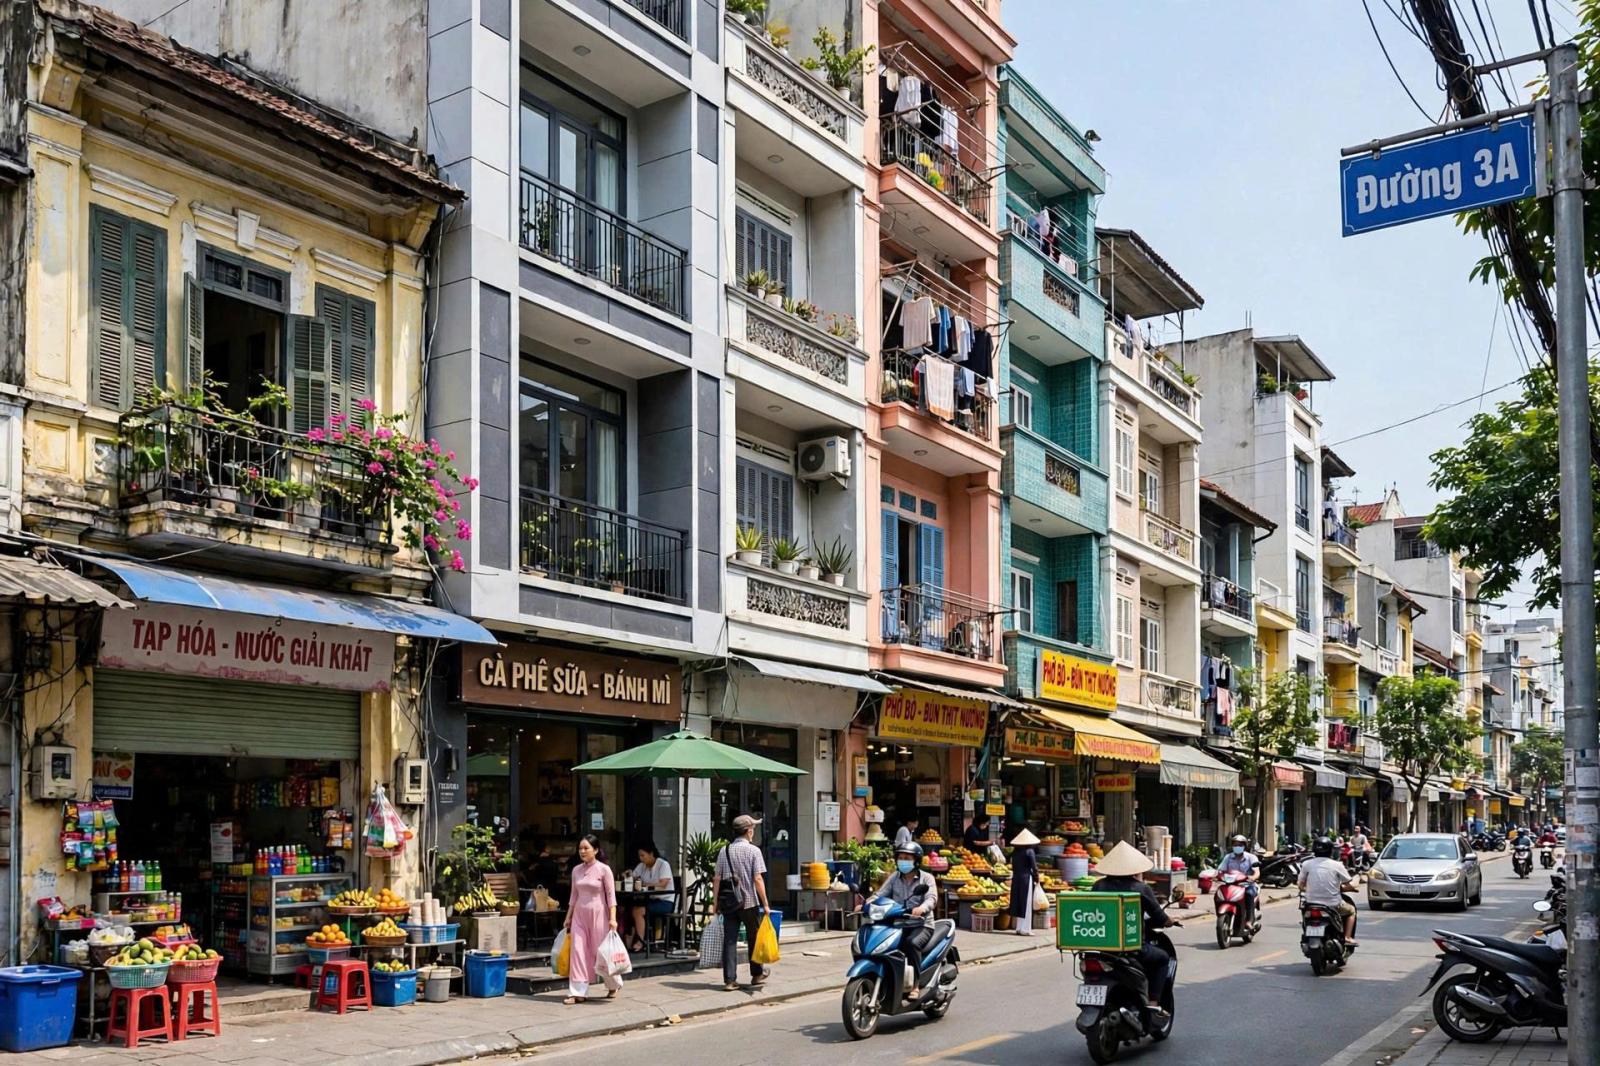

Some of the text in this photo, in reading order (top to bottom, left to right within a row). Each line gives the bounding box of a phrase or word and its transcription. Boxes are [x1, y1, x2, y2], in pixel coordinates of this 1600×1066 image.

[1356, 142, 1519, 214] Đường 3A
[132, 619, 171, 656] TẠP
[177, 620, 216, 656] HÓA
[234, 627, 285, 664] NƯỚC
[290, 631, 325, 668] GIẢI
[329, 639, 373, 672] KHÁT
[480, 652, 507, 688] CÀ
[512, 658, 548, 692] PHÊ
[553, 662, 588, 696] SỮA
[604, 668, 648, 703] BÁNH
[652, 674, 671, 705] MÌ
[1072, 908, 1106, 923] Grab
[1072, 925, 1106, 937] Food
